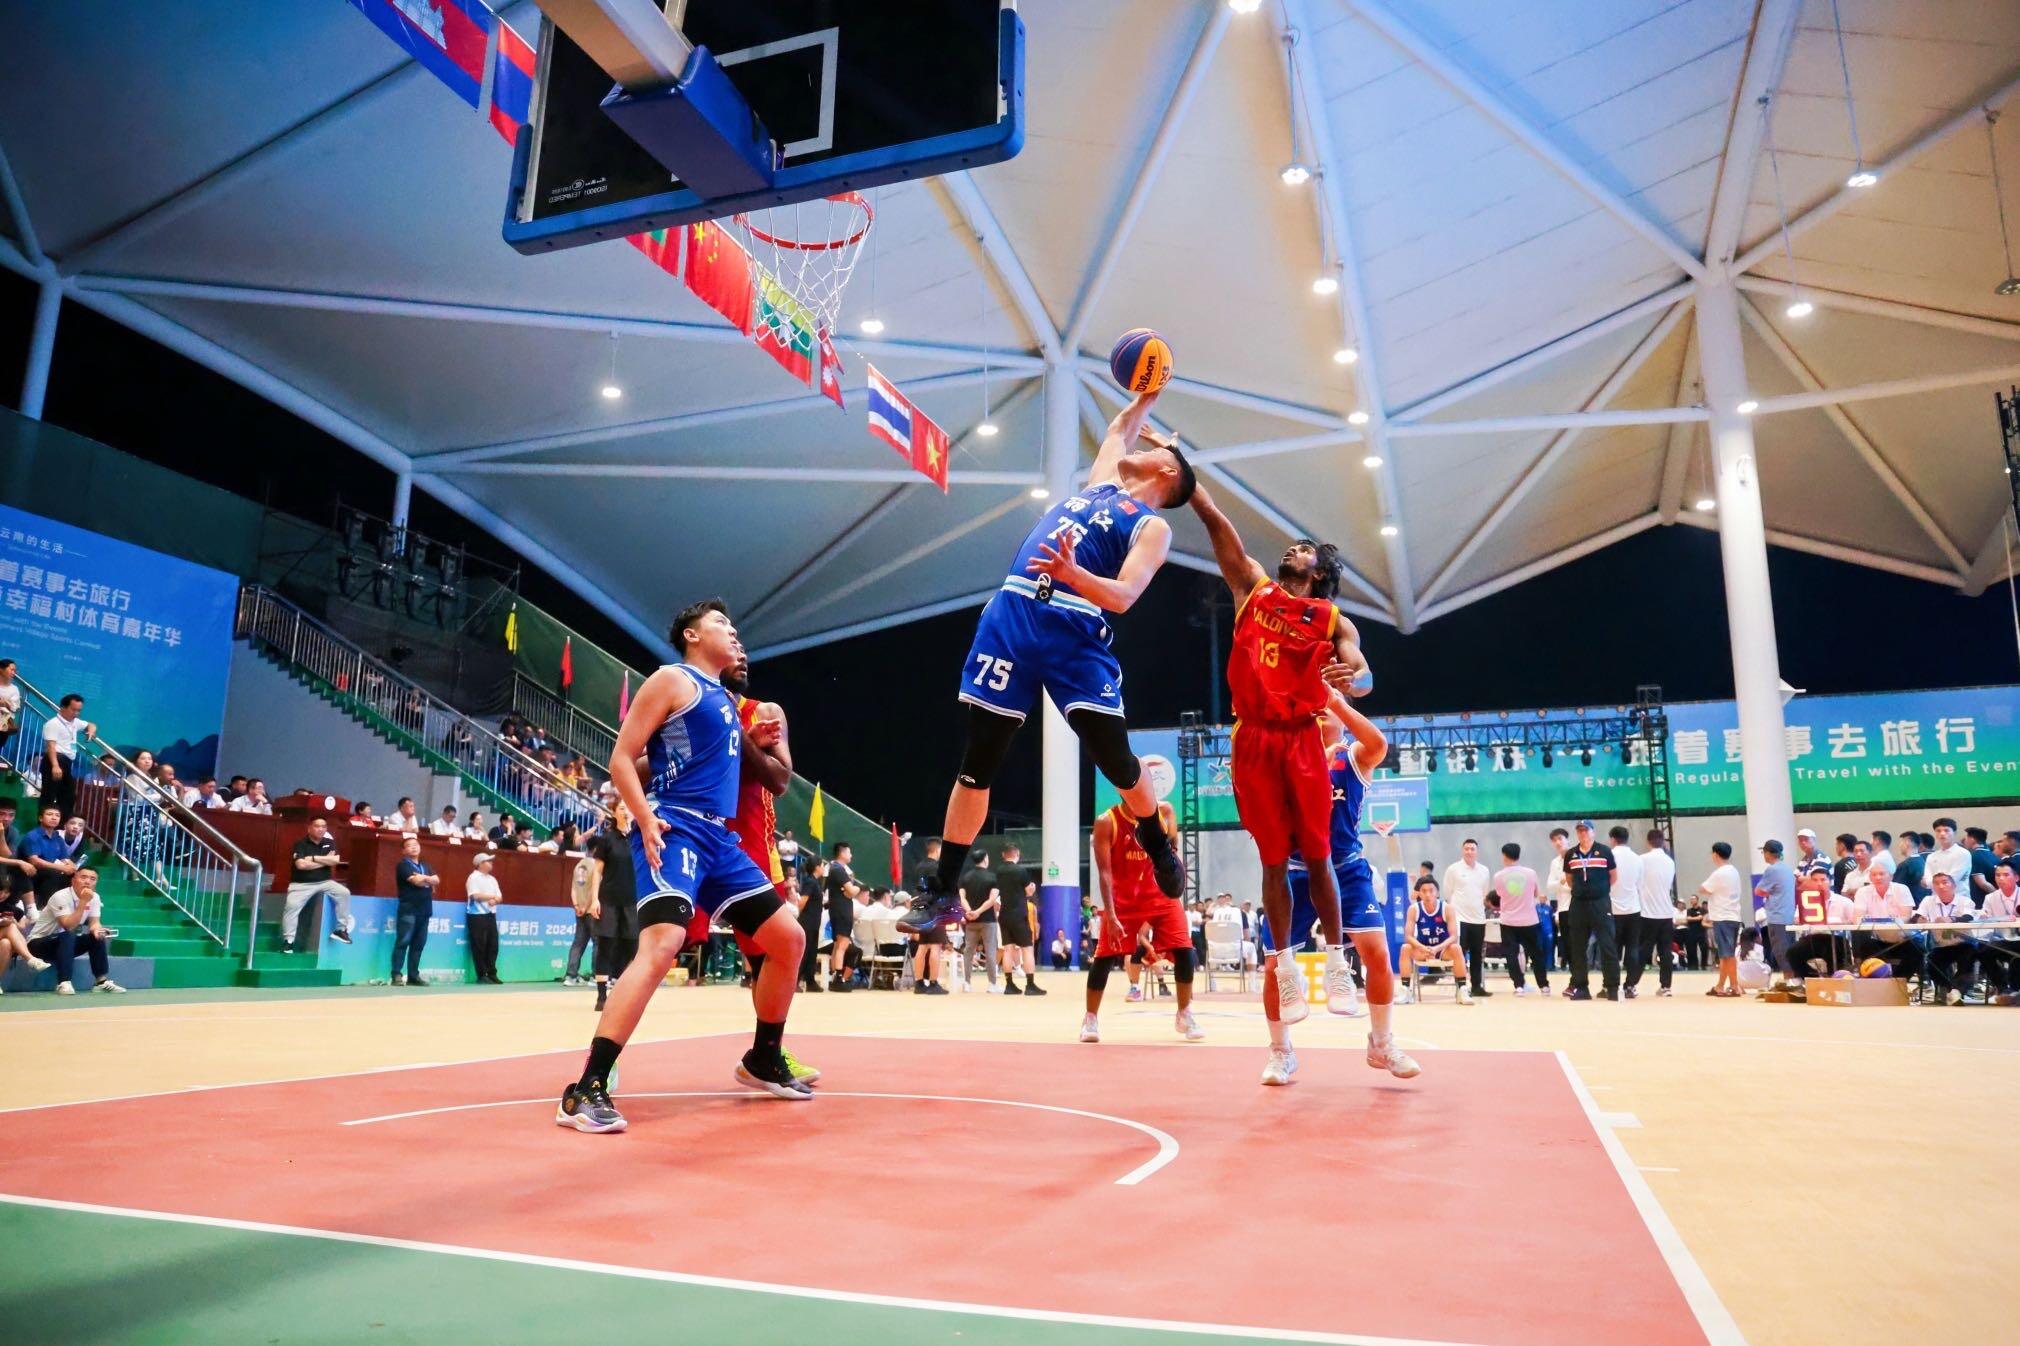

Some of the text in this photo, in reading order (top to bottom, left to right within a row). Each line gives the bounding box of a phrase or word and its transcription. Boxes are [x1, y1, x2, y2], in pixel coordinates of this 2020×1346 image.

[0, 586, 182, 648] 幸福村体育嘉年华
[1259, 637, 1280, 669] 13
[973, 653, 1014, 691] 75
[1674, 770, 1742, 786] Regula
[1795, 765, 1858, 780] Travel
[1869, 762, 1911, 777] with
[1922, 761, 1955, 775] the
[1966, 760, 2020, 773] Even
[680, 848, 698, 880] 13
[1801, 890, 1824, 923] 5
